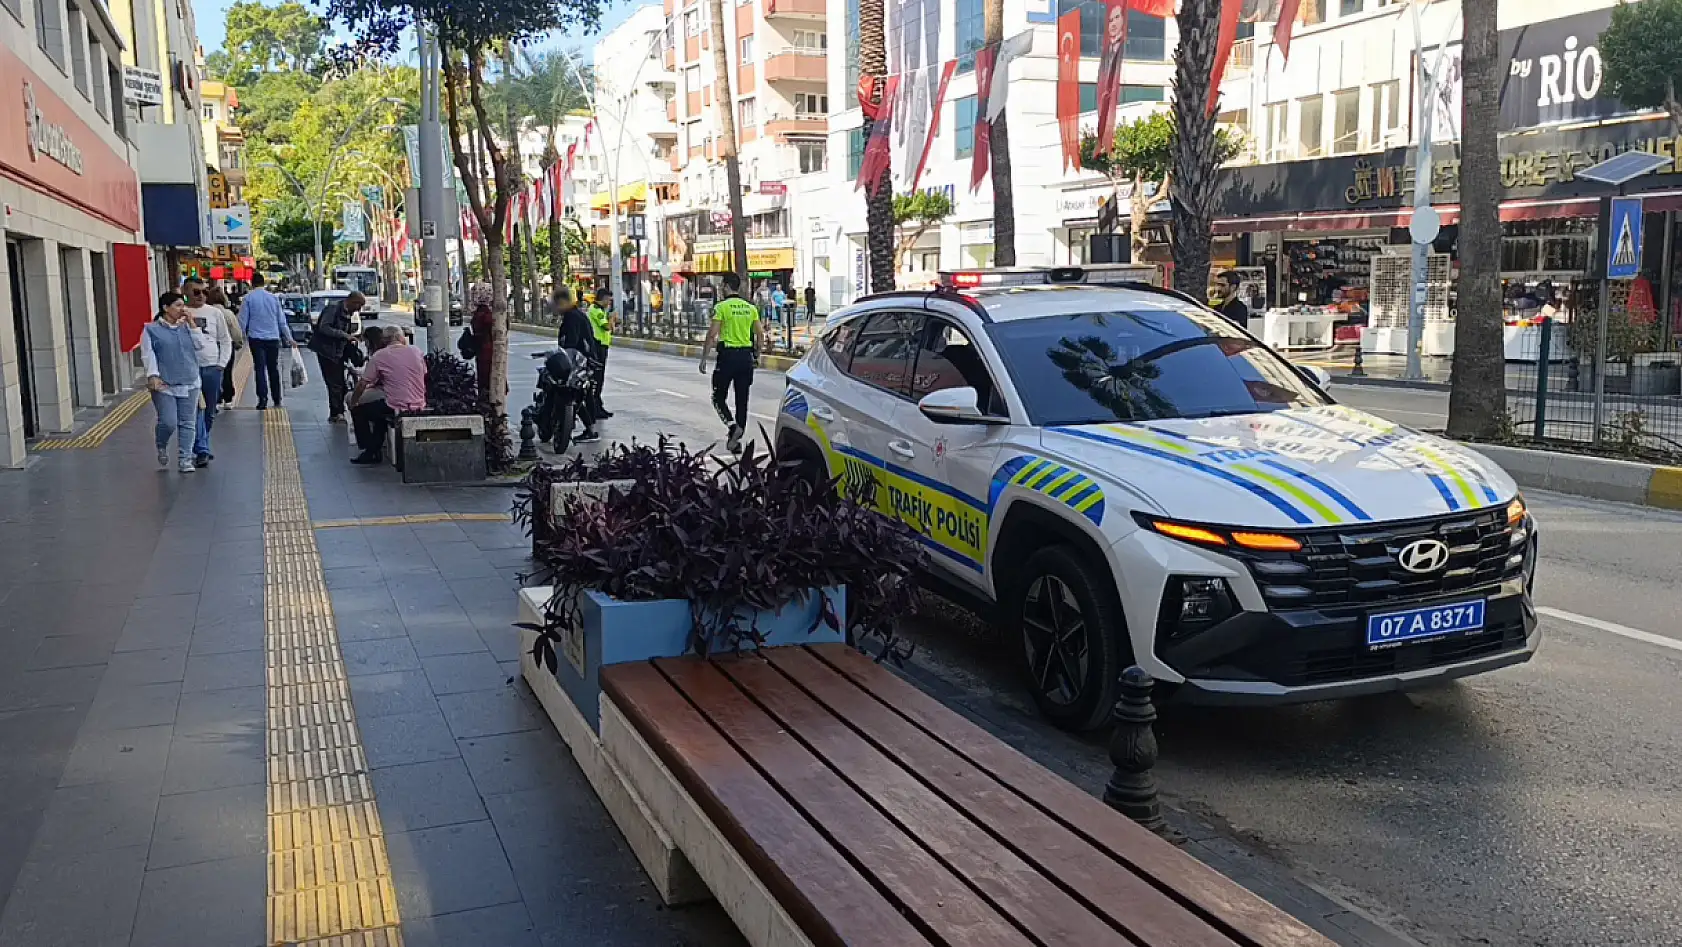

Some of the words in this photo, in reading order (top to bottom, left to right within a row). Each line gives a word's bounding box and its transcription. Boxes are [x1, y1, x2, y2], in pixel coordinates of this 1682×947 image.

[1510, 57, 1533, 78] by
[887, 485, 933, 527] TRAFİK
[936, 506, 981, 551] POLİSİ
[1380, 616, 1406, 637] 07
[1409, 613, 1426, 634] A
[1430, 605, 1475, 629] 8371
